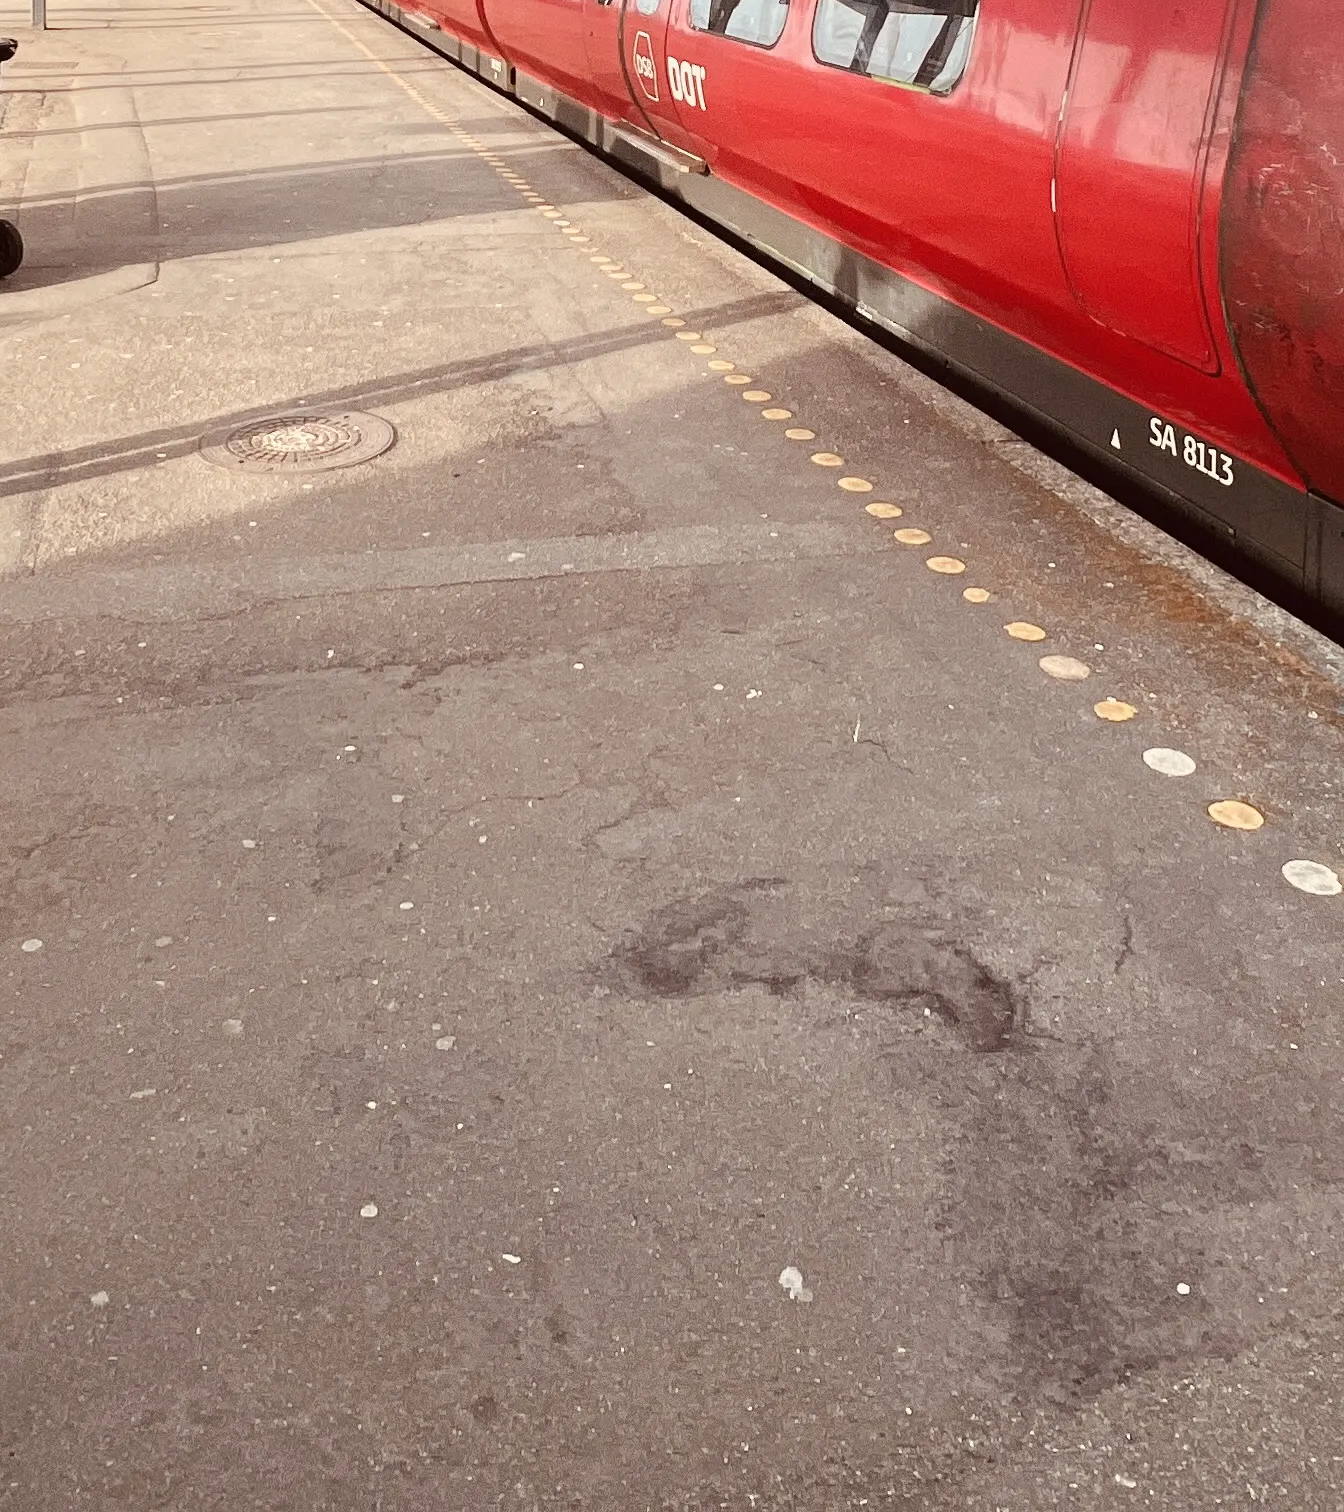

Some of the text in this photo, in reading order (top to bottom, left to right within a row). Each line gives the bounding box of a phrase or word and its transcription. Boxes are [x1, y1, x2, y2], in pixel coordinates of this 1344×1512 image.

[667, 56, 707, 112] DOT
[1149, 417, 1234, 486] SA 8113
